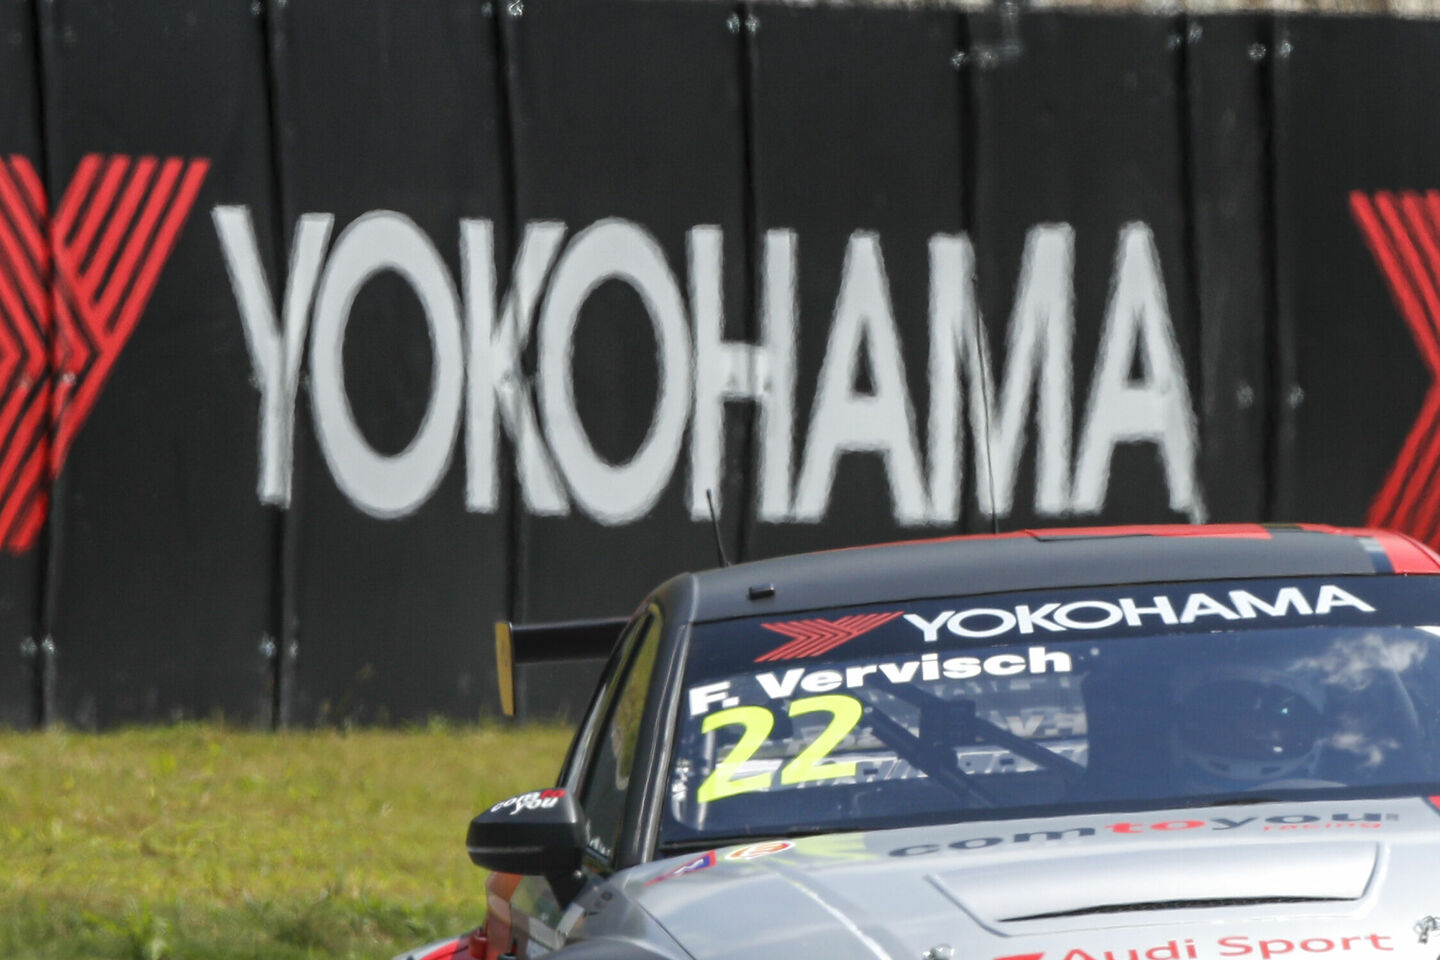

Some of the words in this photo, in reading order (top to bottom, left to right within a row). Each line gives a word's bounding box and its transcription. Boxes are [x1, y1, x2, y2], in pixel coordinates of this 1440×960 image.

[211, 204, 1206, 525] YOKOHAMA
[903, 584, 1375, 642] YOKOHAMA
[689, 680, 739, 716] F.
[756, 647, 1071, 699] Vervisch
[697, 694, 863, 803] 22
[1217, 933, 1395, 960] Sport
